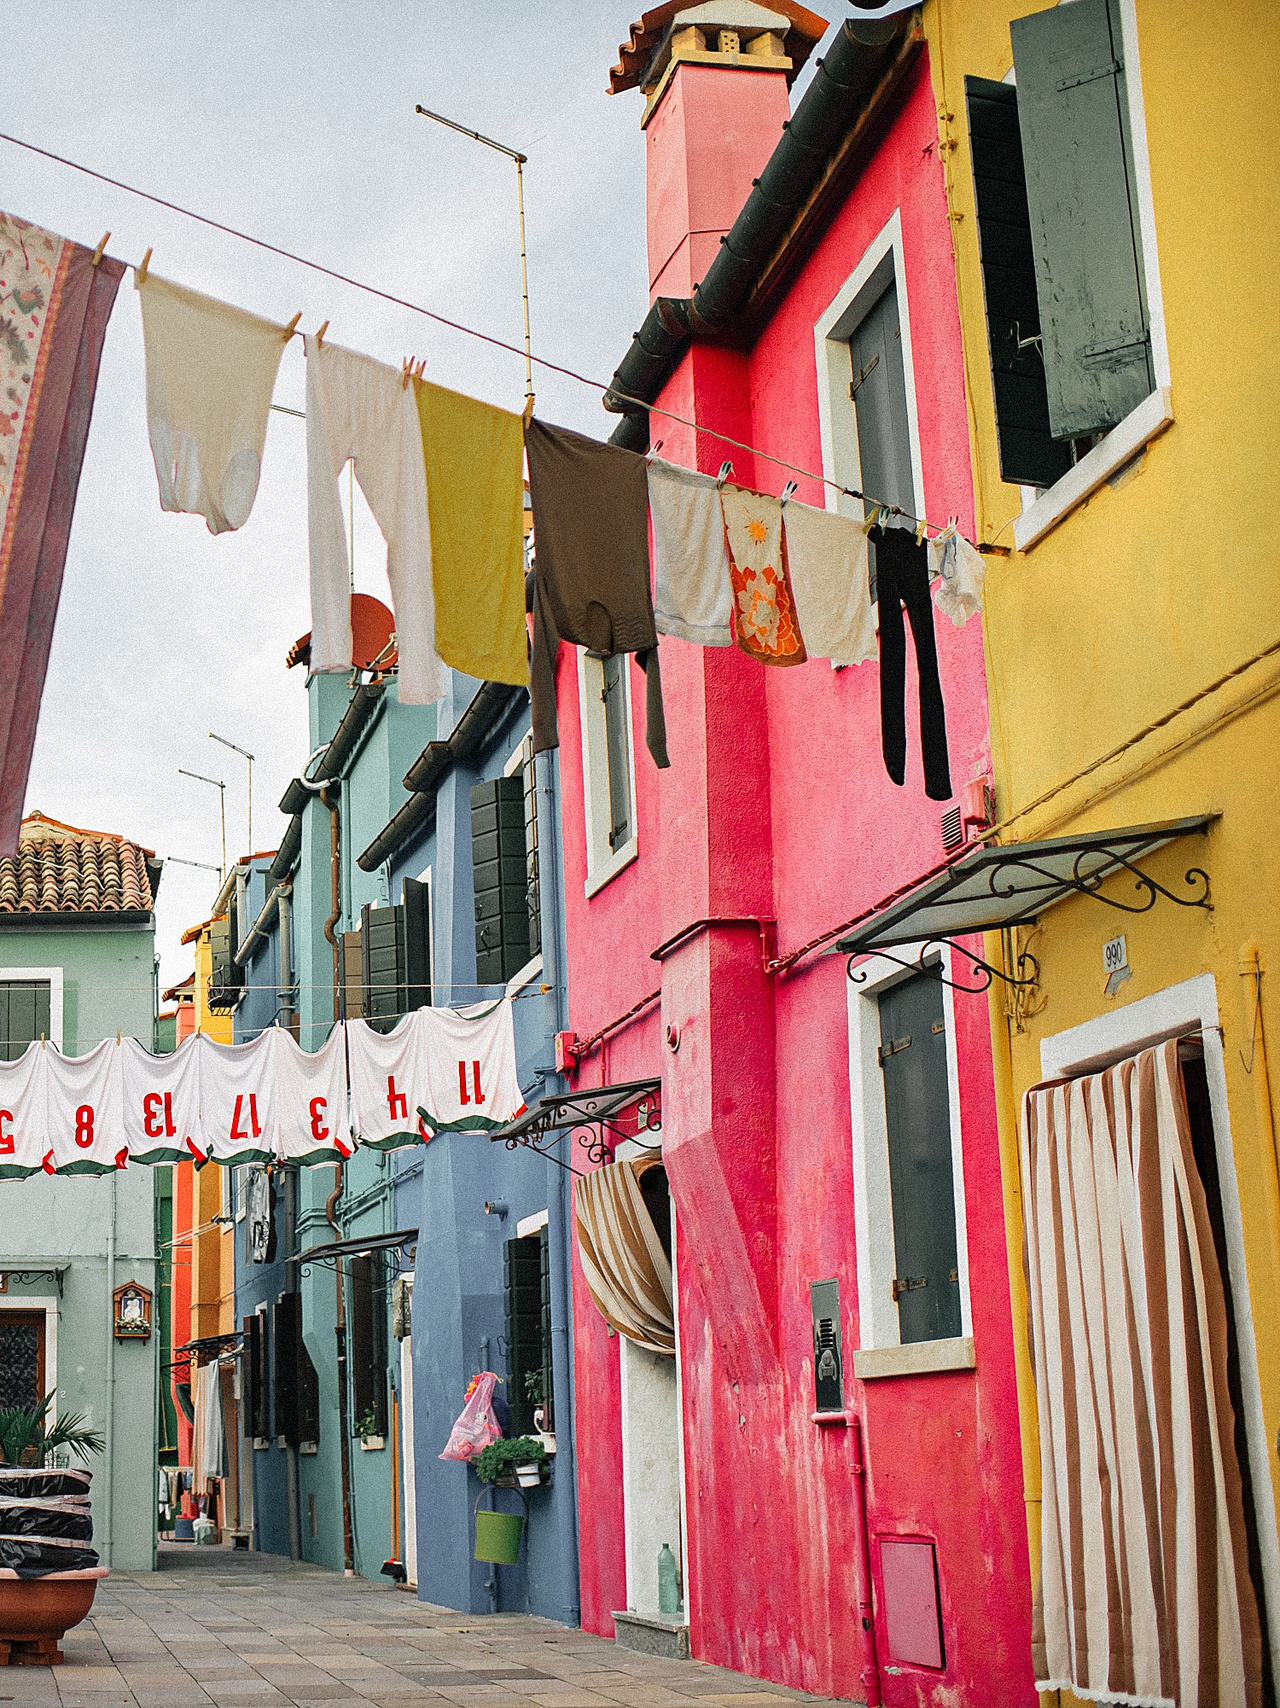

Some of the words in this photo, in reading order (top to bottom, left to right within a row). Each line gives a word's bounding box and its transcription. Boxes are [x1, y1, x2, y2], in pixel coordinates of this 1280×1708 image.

[1105, 941, 1123, 968] 990
[386, 1075, 409, 1121] 4
[458, 1060, 486, 1106] 11
[74, 1104, 95, 1149] 8
[143, 1091, 177, 1138] 13
[229, 1093, 262, 1140] 17
[309, 1096, 329, 1140] 3
